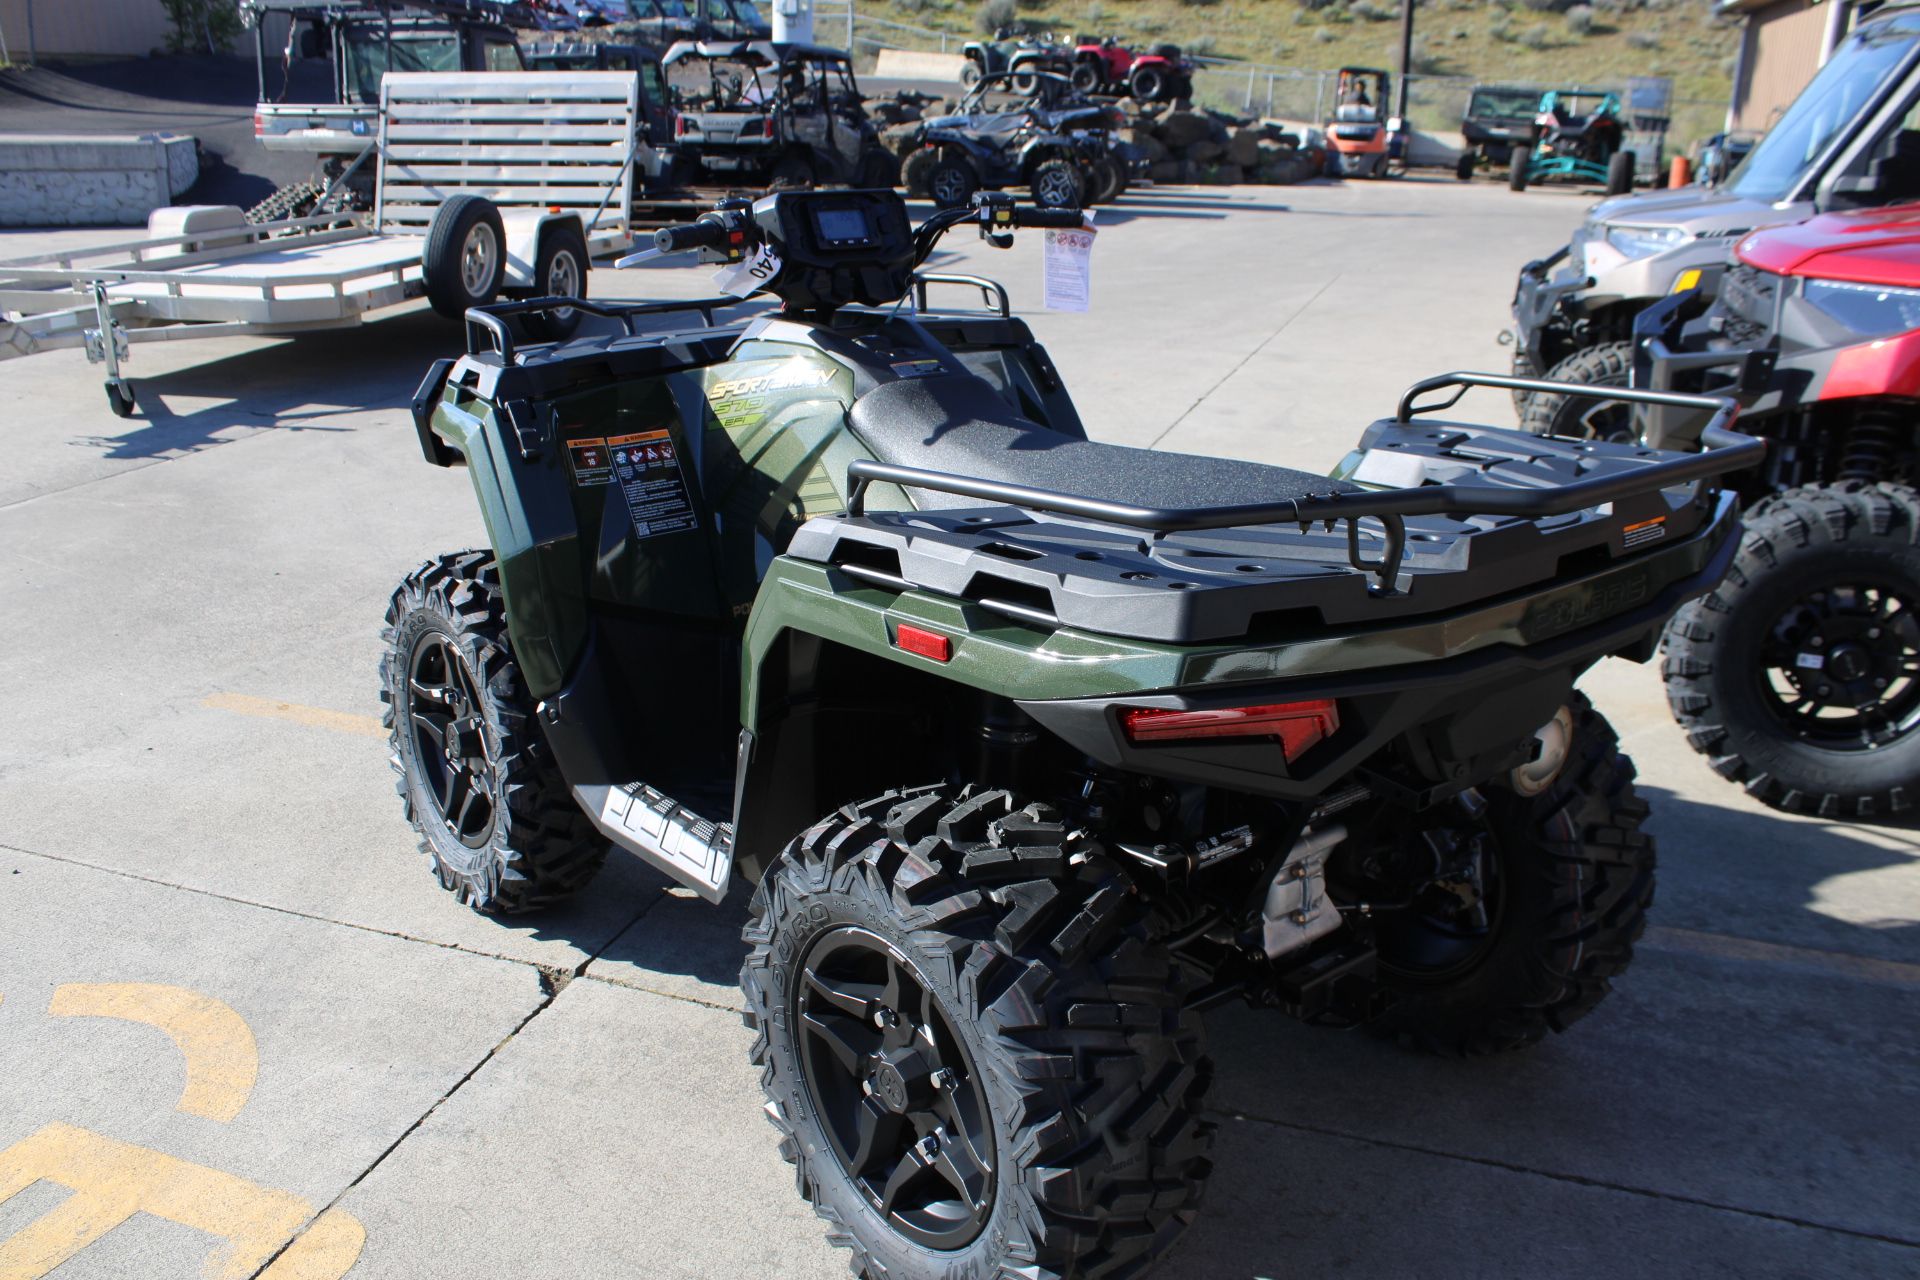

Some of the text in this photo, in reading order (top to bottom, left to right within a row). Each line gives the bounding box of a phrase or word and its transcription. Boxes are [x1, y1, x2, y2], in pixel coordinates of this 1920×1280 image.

[709, 368, 839, 400] SPORTSMAN
[714, 396, 765, 414] 570
[724, 417, 746, 427] EFI
[587, 458, 596, 466] 16
[772, 900, 829, 997] DURO
